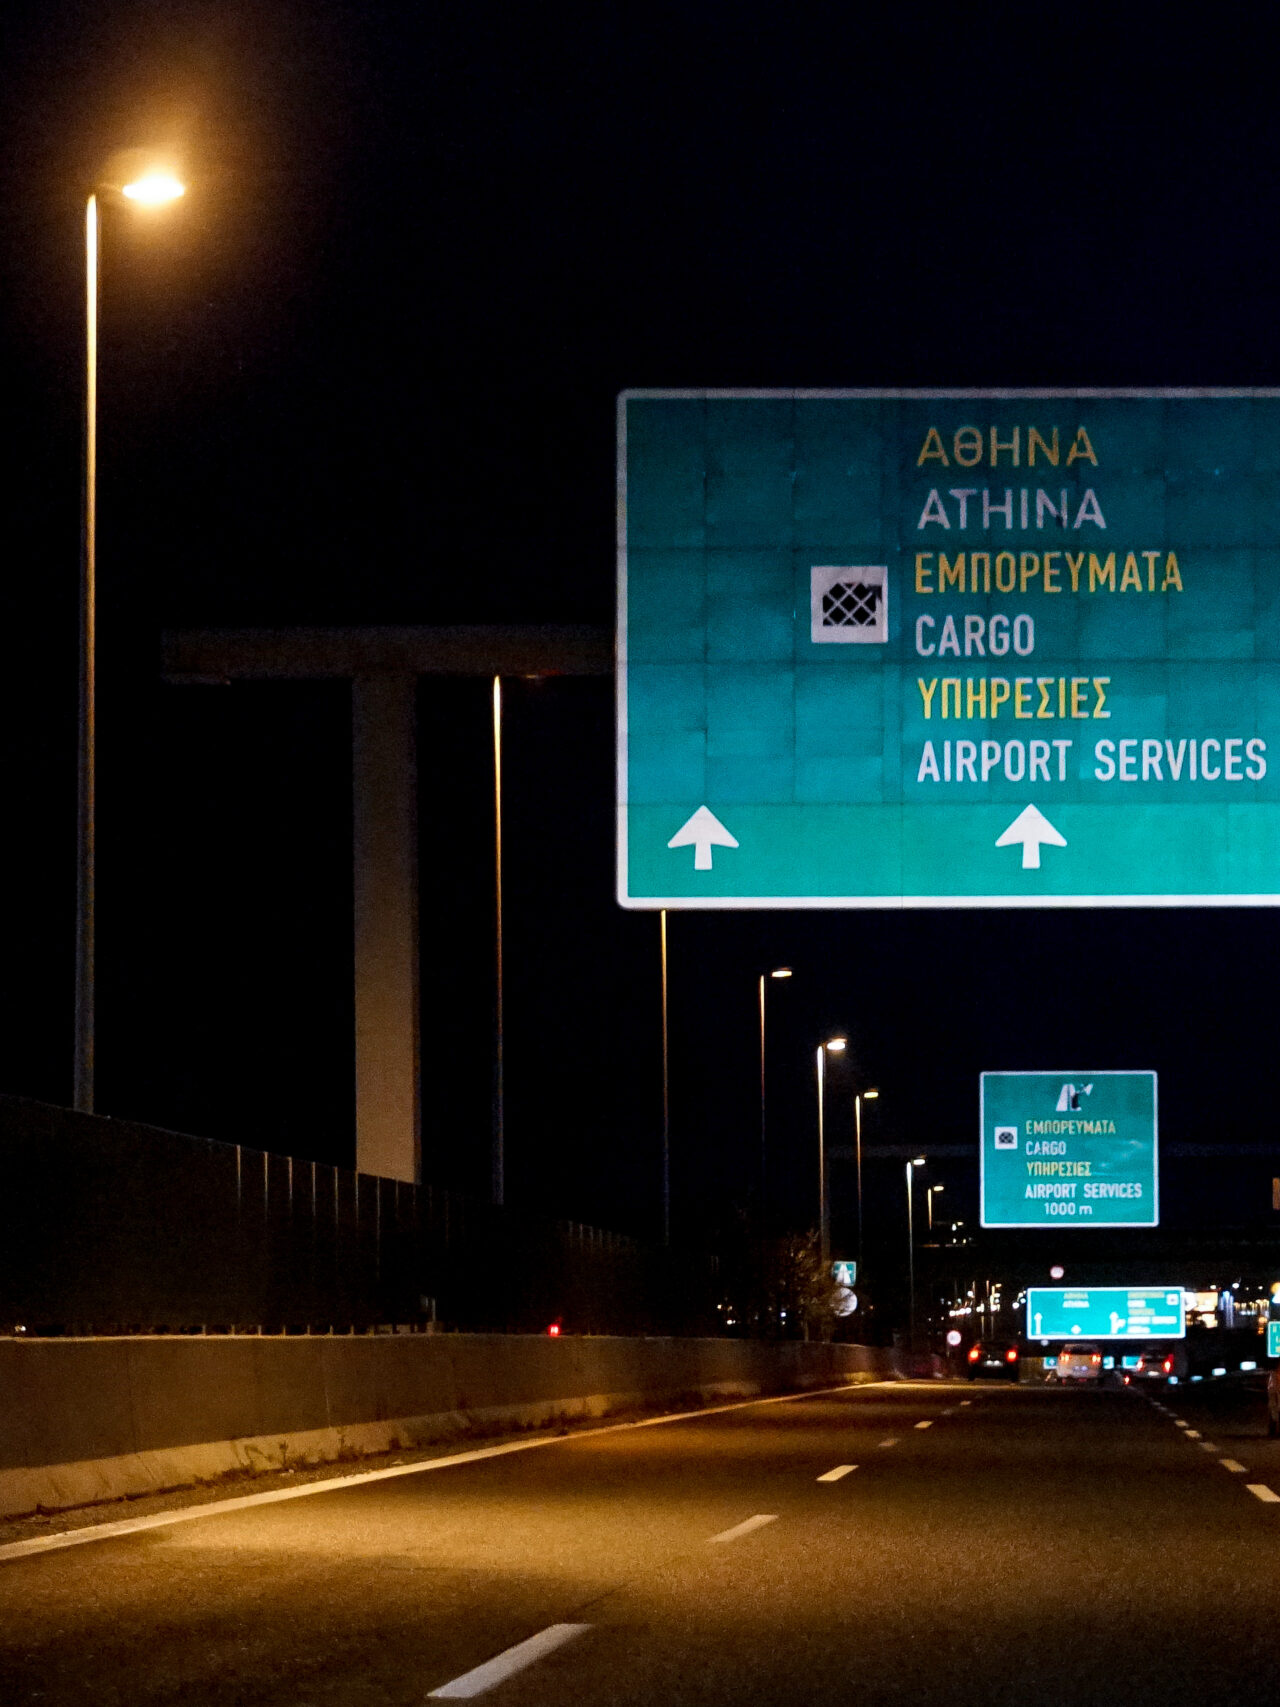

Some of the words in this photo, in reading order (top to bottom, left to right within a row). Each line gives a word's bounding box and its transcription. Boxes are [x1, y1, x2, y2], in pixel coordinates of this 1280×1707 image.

[918, 427, 1097, 466] ΑΘΗΝΑ
[918, 489, 1106, 529] ATHINA
[916, 552, 1182, 593] ΕΜΠΟΡΕΥΜΑΤΑ
[916, 615, 1034, 656] CARGO
[919, 678, 1110, 718] ΥΠΗΡΕΣΙΕΣ
[918, 740, 1072, 782] AIRPORT
[1095, 739, 1266, 781] SERVICES
[1026, 1120, 1115, 1134] ΕΜΠΟΡΕΥΜΑΤΑ
[1026, 1141, 1066, 1155] CARGO
[1026, 1184, 1076, 1198] AIRPORT
[1084, 1183, 1142, 1198] SERVICES
[1045, 1202, 1075, 1215] 1000
